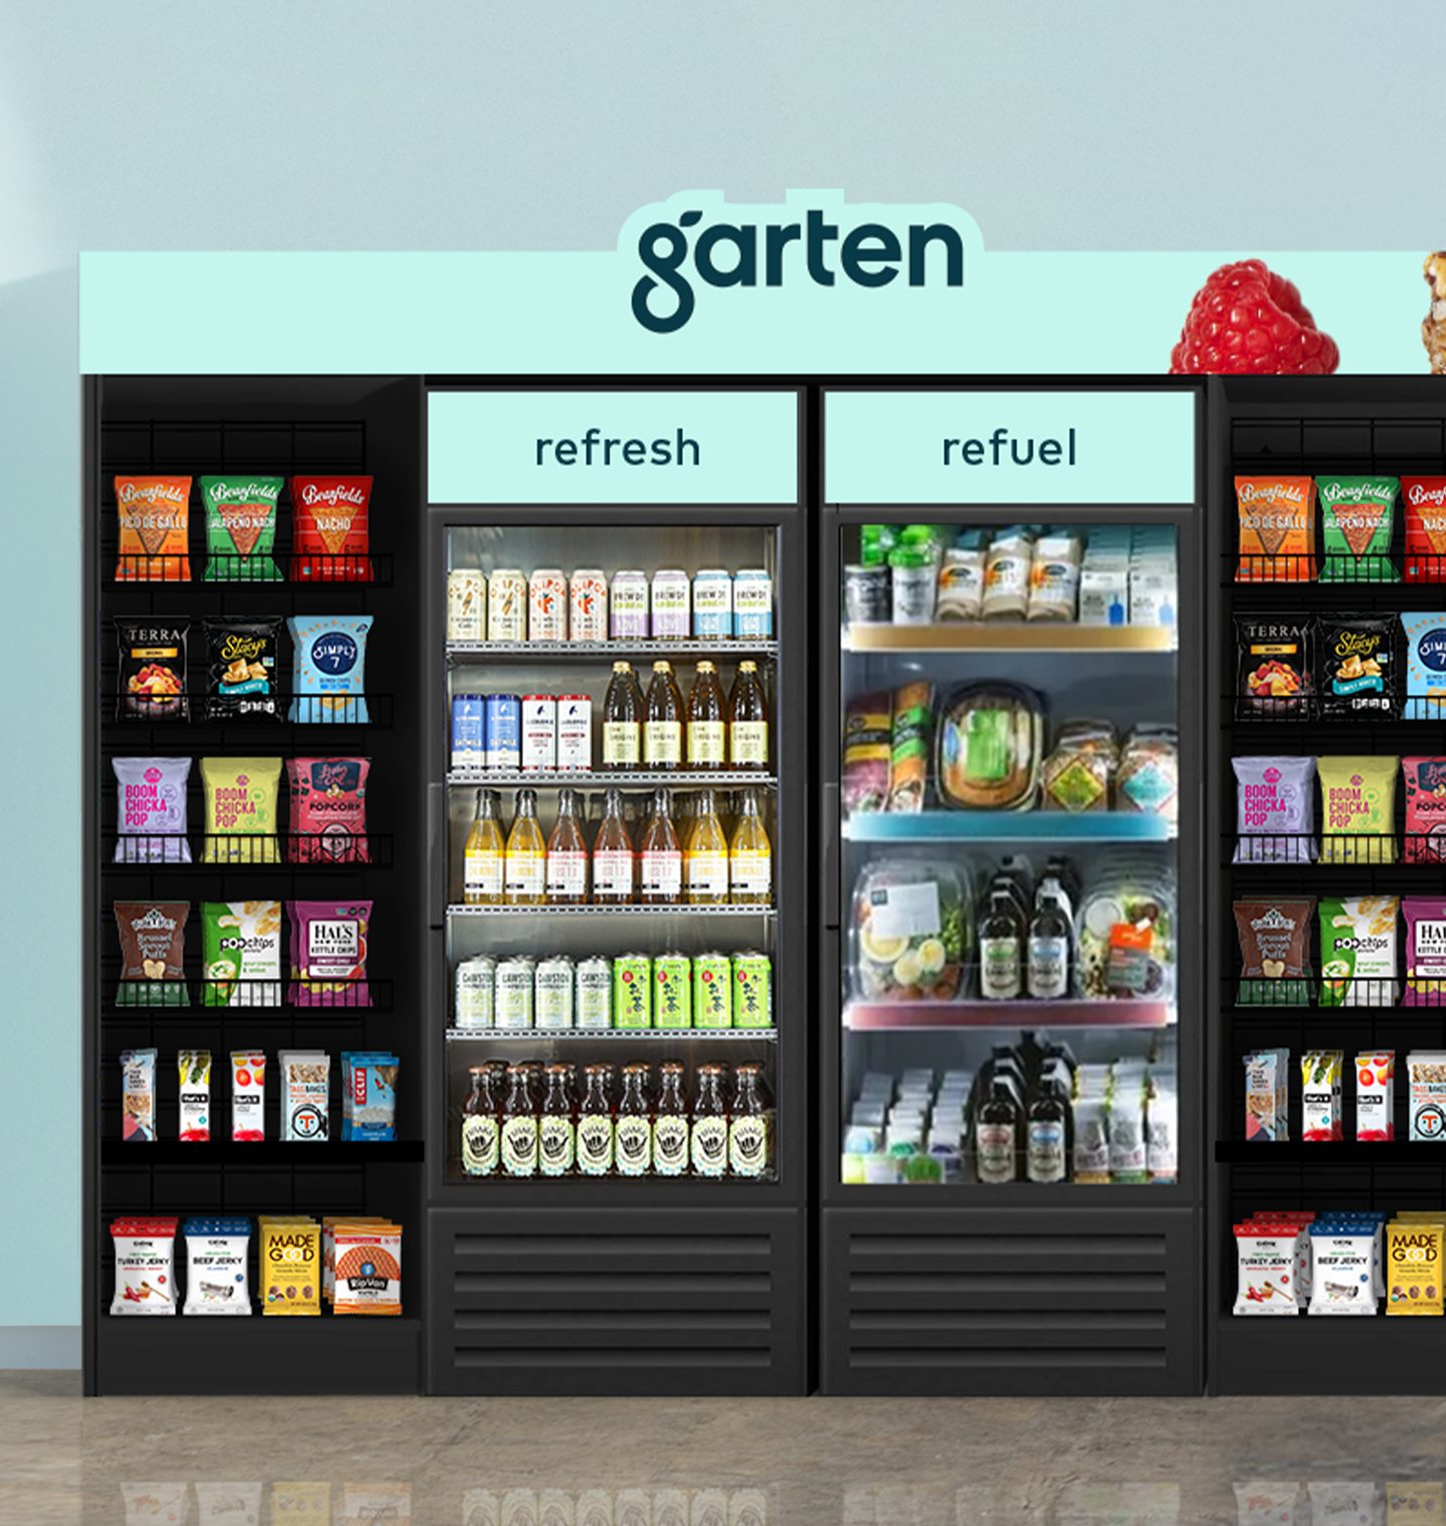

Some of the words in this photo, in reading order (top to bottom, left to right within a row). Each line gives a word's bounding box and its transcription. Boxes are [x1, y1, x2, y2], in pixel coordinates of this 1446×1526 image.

[631, 210, 963, 334] garten
[536, 428, 700, 466] refresh
[943, 428, 1077, 466] refuel
[317, 518, 351, 531] NACHO
[129, 629, 180, 641] TERRA
[1248, 625, 1300, 637] TERRA
[313, 645, 356, 659] SIMPLY
[330, 656, 340, 668] 7
[125, 784, 158, 798] BOOM
[215, 788, 247, 801] BOOM
[1244, 784, 1277, 798] BOOM
[1329, 788, 1361, 801] BOOM
[125, 799, 167, 812] CHICKA
[215, 802, 256, 814] CHICKA
[1244, 799, 1287, 812] CHICKA
[1329, 802, 1370, 814] CHICKA
[125, 812, 148, 826] POP
[215, 815, 238, 828] POP
[1244, 812, 1267, 826] POP
[1329, 815, 1351, 828] POP
[315, 924, 353, 939] HAL'S
[219, 937, 275, 951] popchips
[1333, 937, 1388, 952] popchips
[269, 1234, 314, 1248] MADE
[1392, 1233, 1437, 1248] MADE
[193, 1257, 214, 1265] BEEF
[215, 1257, 243, 1265] JERKY
[269, 1247, 314, 1262] GOOD
[1318, 1257, 1339, 1265] BEEF
[1340, 1257, 1368, 1265] JERKY
[1392, 1247, 1437, 1262] GOOD
